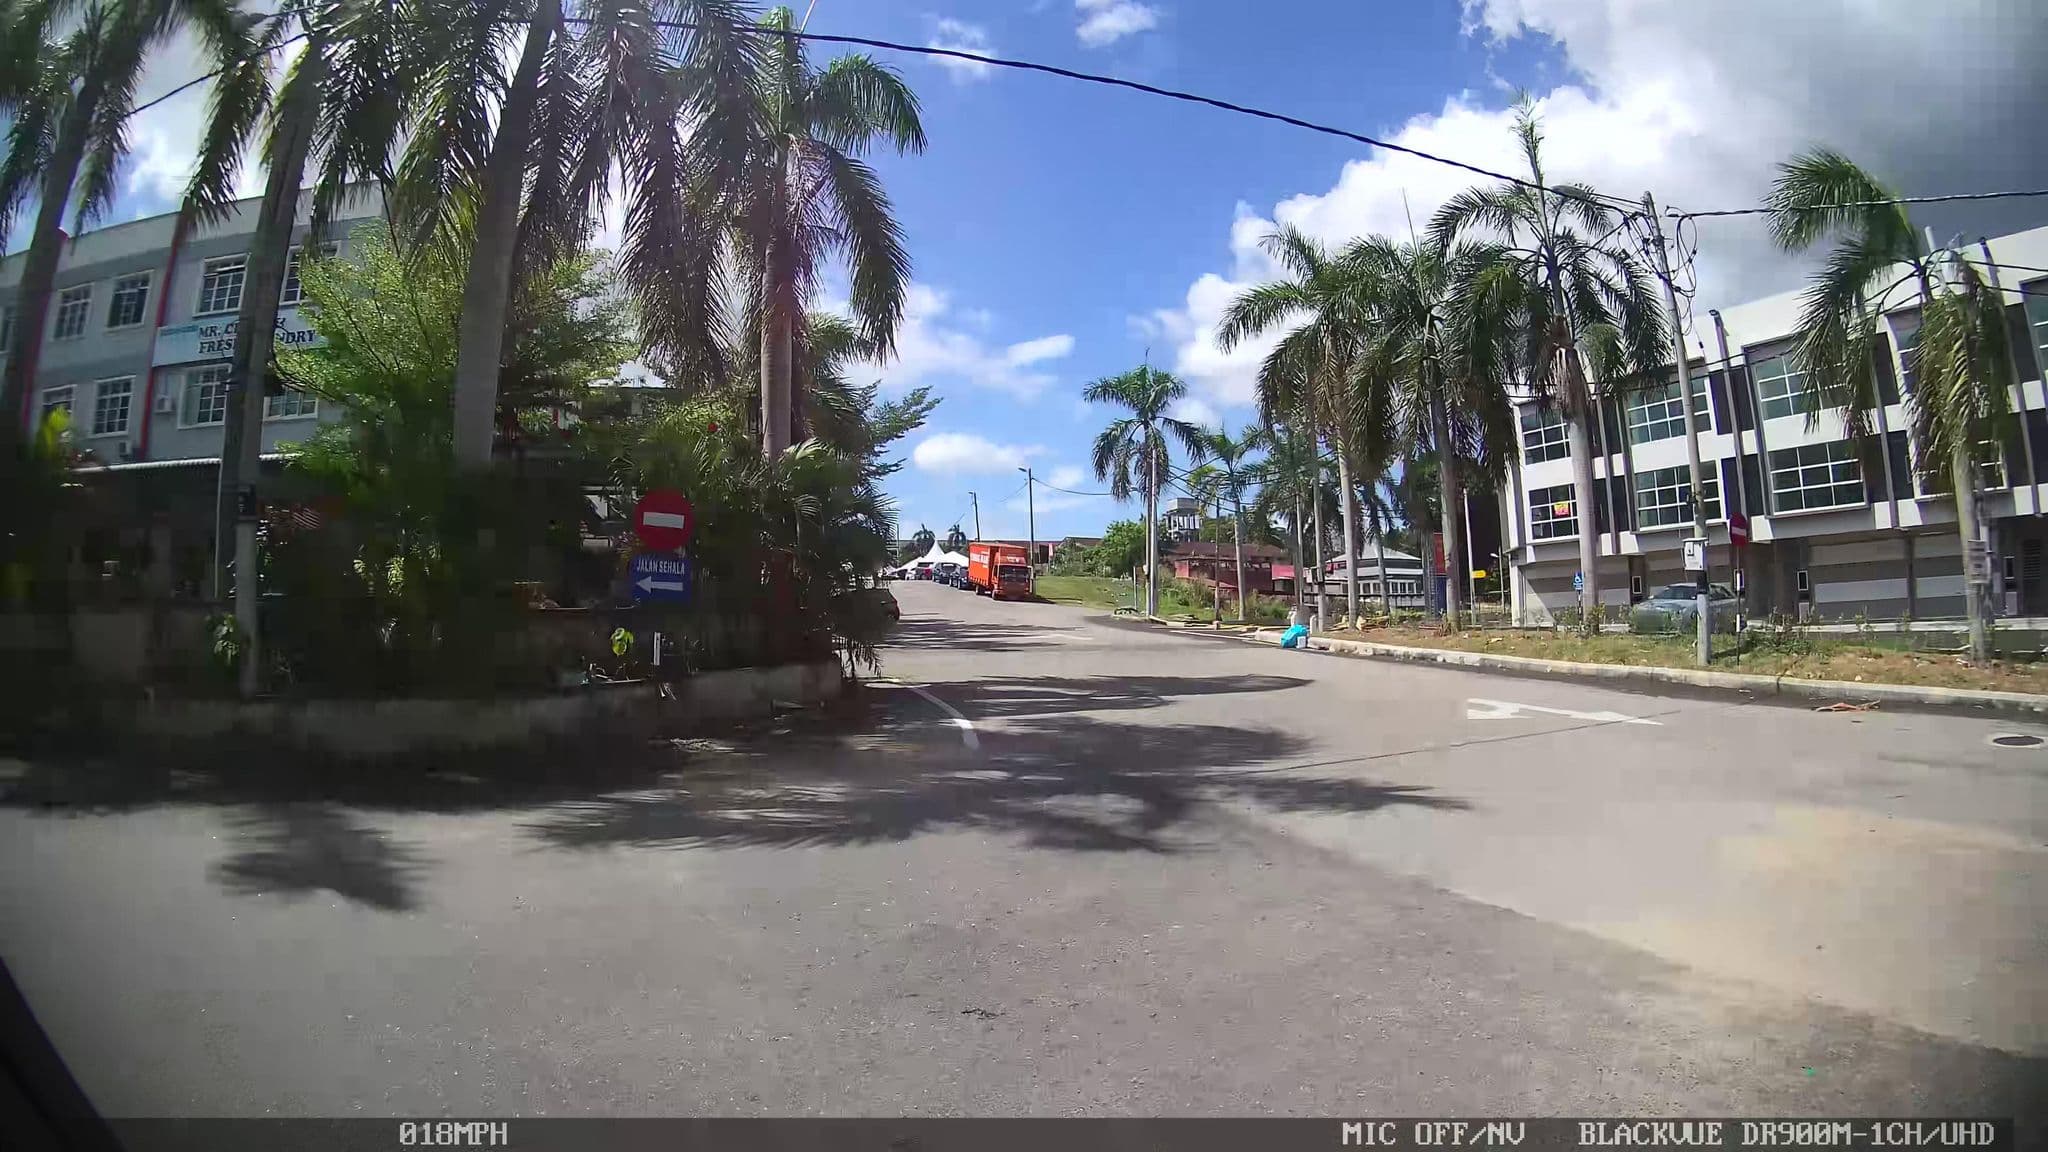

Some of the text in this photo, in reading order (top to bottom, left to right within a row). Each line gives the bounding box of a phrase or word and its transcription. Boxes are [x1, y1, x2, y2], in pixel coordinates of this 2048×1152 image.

[199, 338, 236, 354] FRES
[636, 559, 685, 576] JALAN SEHALA
